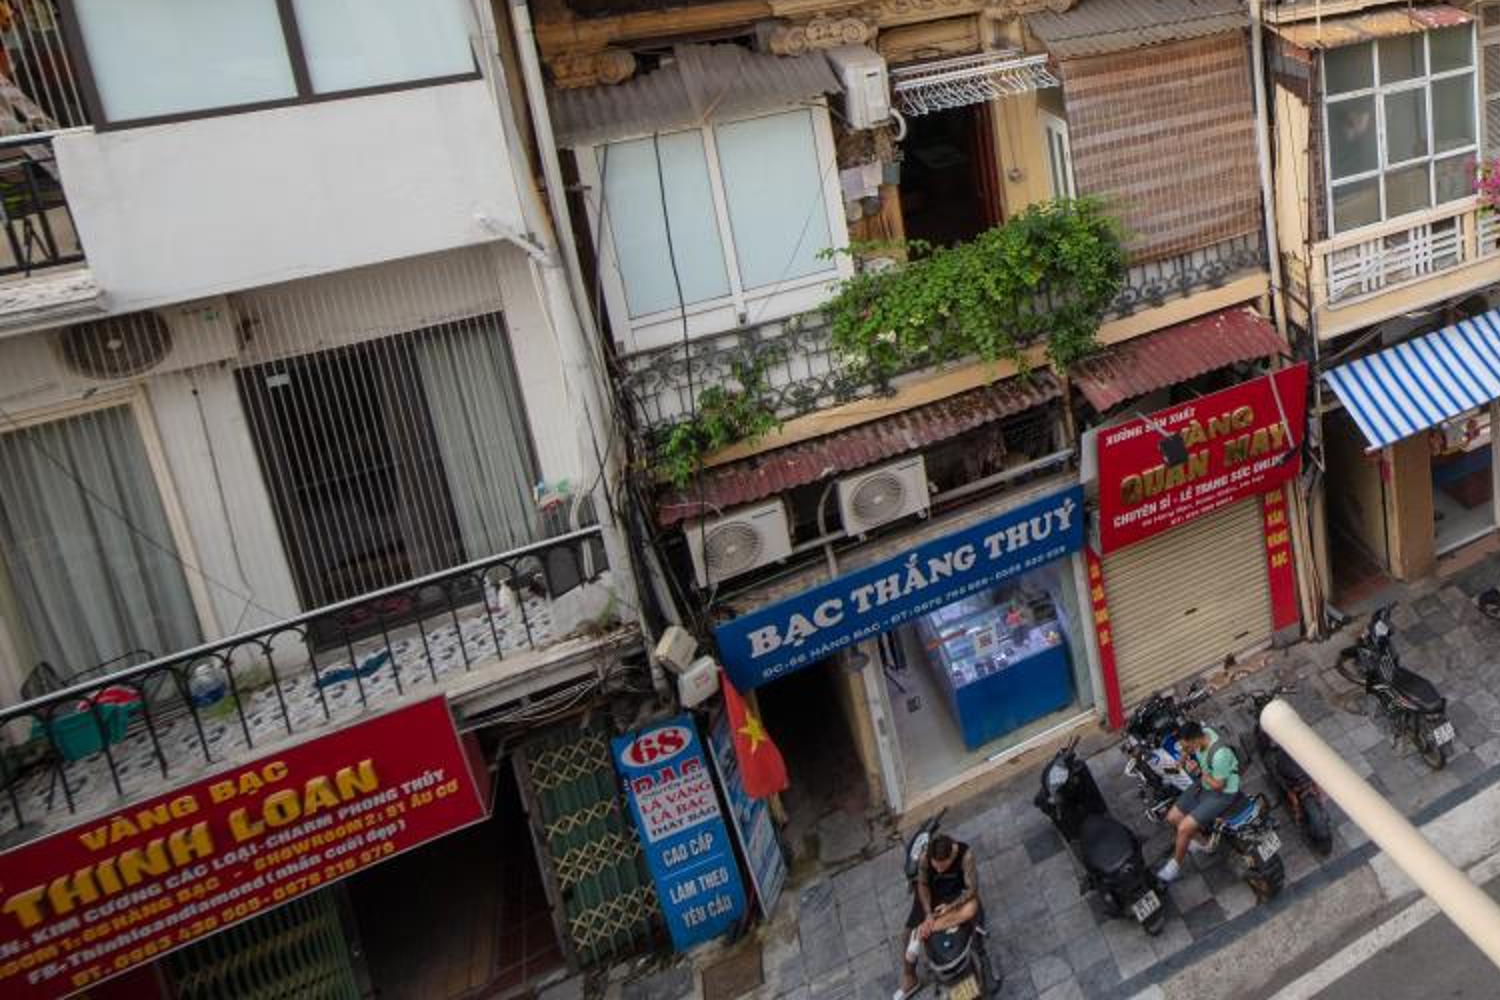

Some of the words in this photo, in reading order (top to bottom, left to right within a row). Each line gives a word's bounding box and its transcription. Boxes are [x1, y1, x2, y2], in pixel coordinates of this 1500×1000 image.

[747, 598, 845, 659] BẠC
[850, 545, 977, 614] THẮNG
[631, 727, 684, 765] 68
[79, 794, 199, 852] VÀNG
[209, 760, 289, 803] BẠC
[228, 758, 380, 842] LOAN
[32, 916, 80, 944] KIM
[83, 883, 162, 924] CƯƠNG
[166, 863, 208, 890] CÁC
[337, 788, 399, 819] PHONG
[662, 842, 688, 868] CAO
[690, 832, 714, 857] CẤP
[699, 866, 729, 892] THEO
